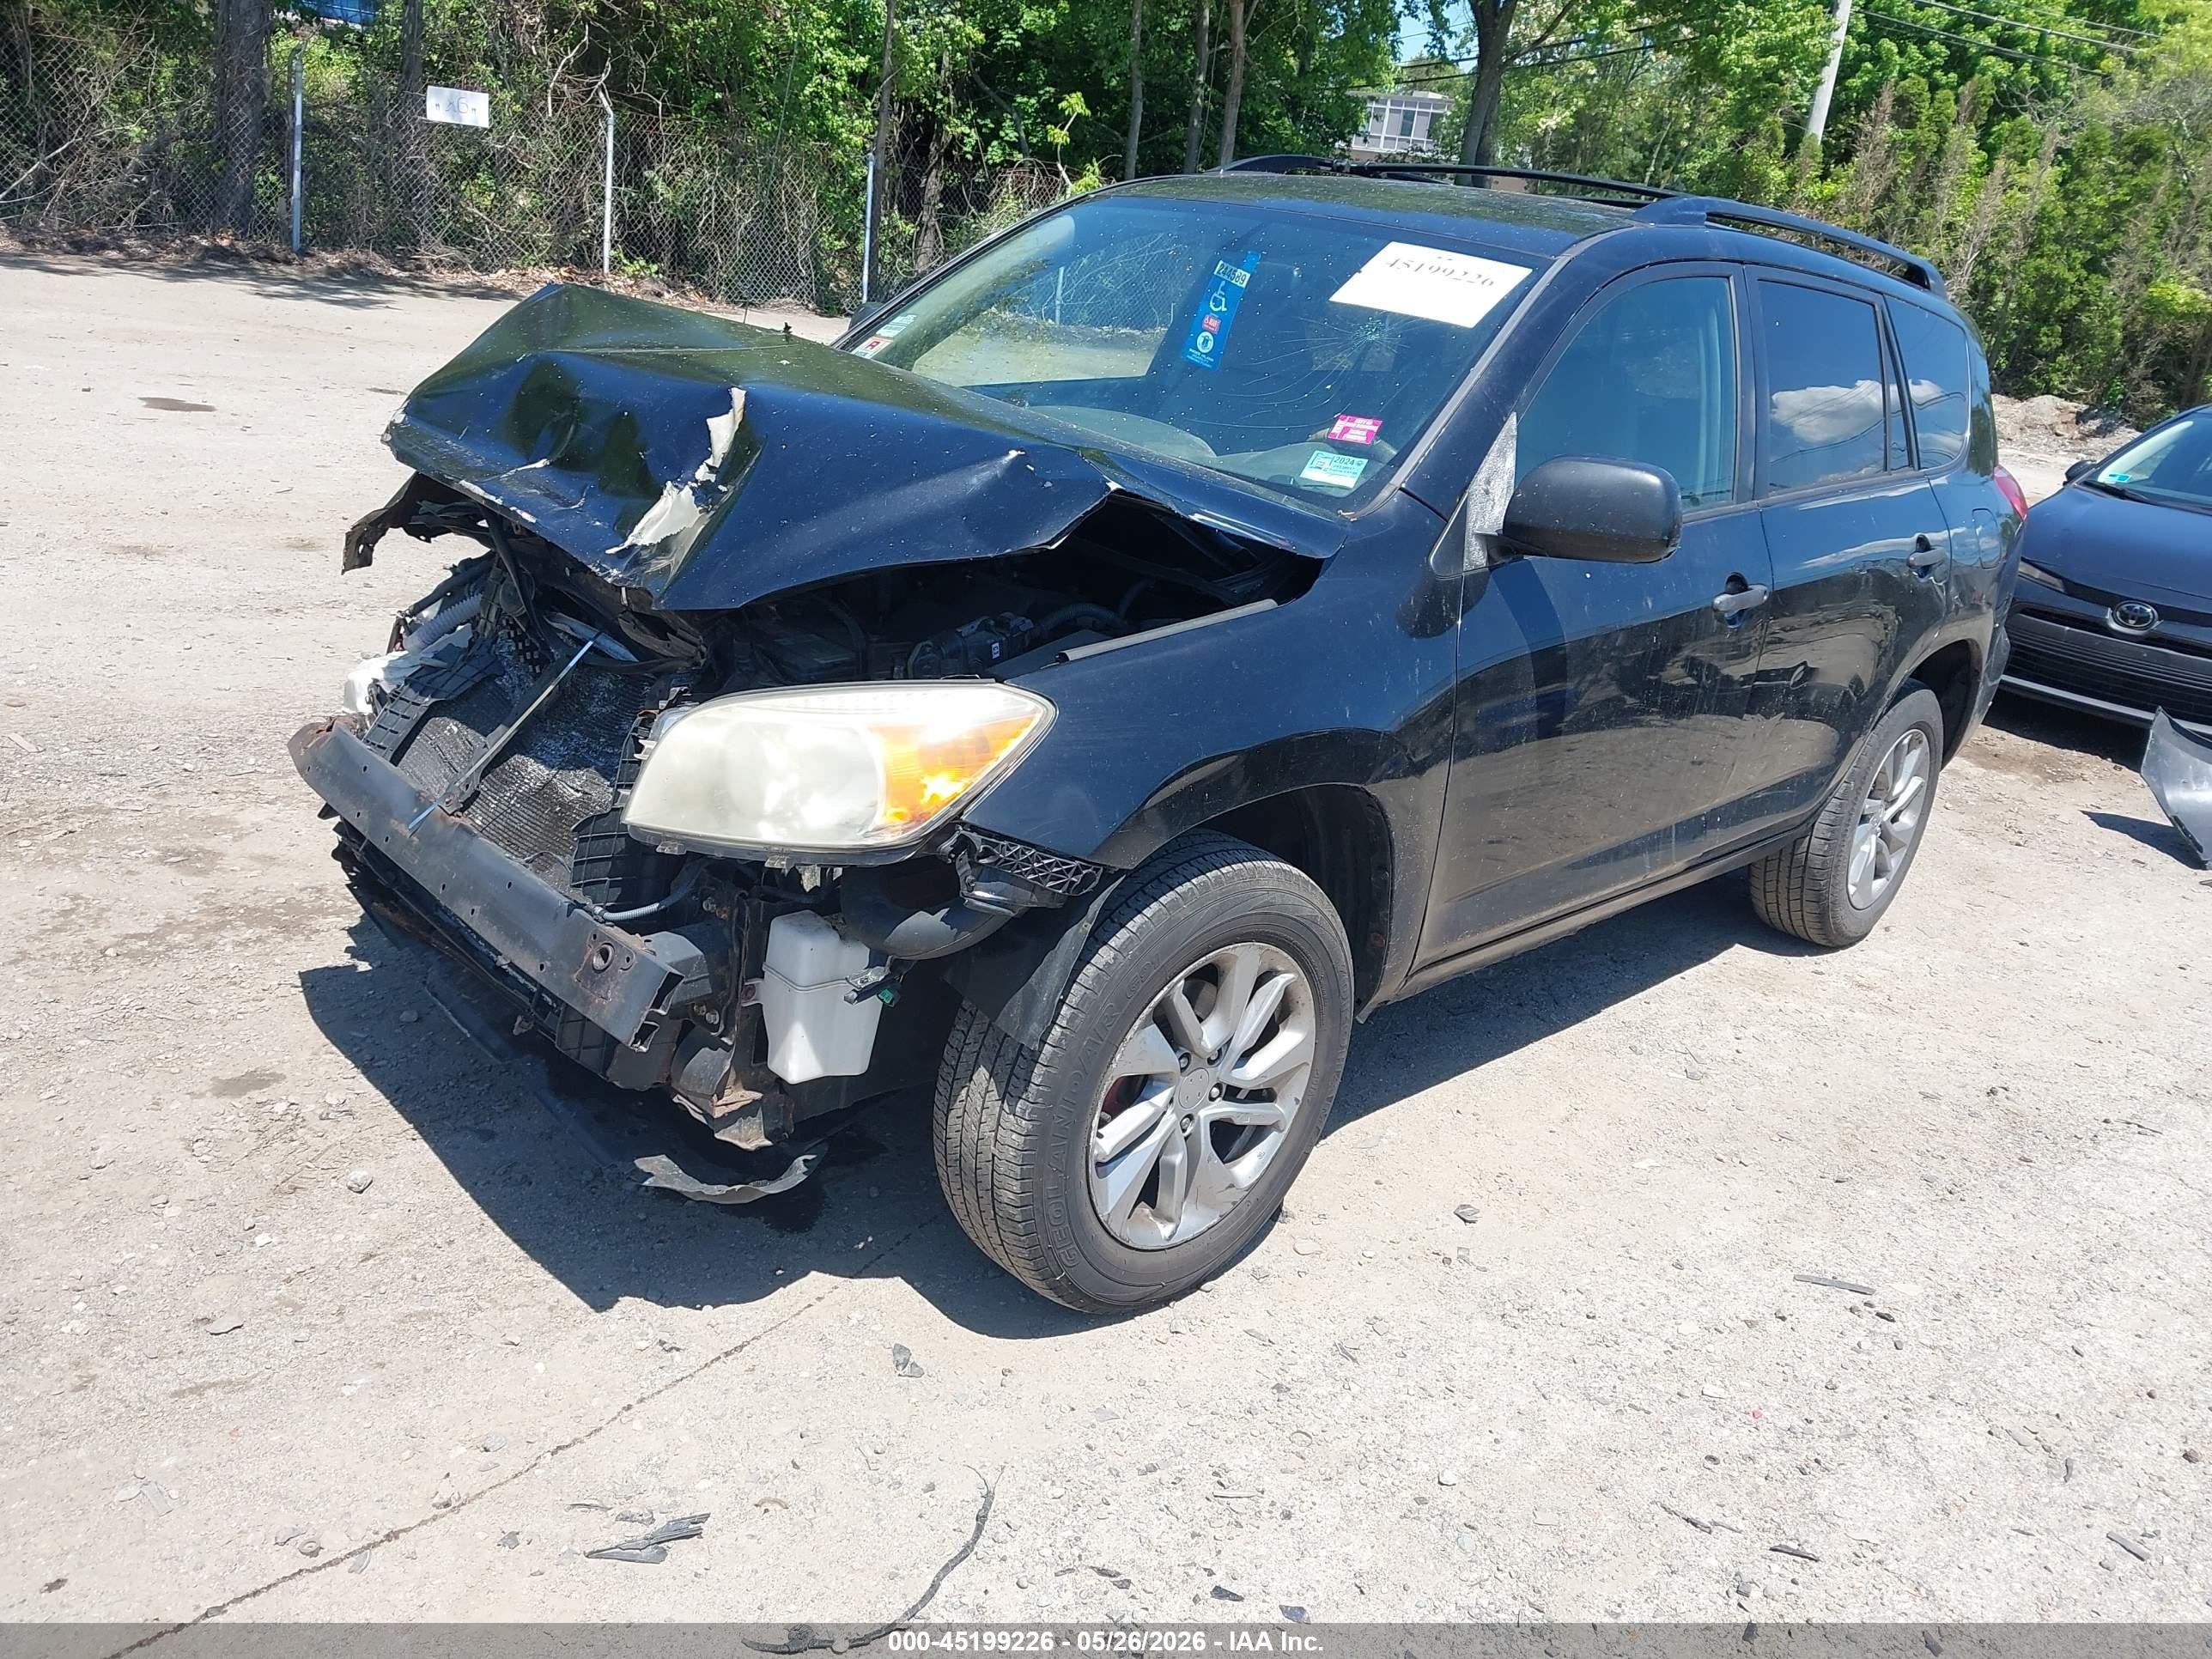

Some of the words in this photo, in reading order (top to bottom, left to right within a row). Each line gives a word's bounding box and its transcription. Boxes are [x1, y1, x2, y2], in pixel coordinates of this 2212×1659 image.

[1217, 264, 1247, 285] 244589
[1385, 258, 1495, 287] 45199226
[1334, 457, 1355, 465] 2024
